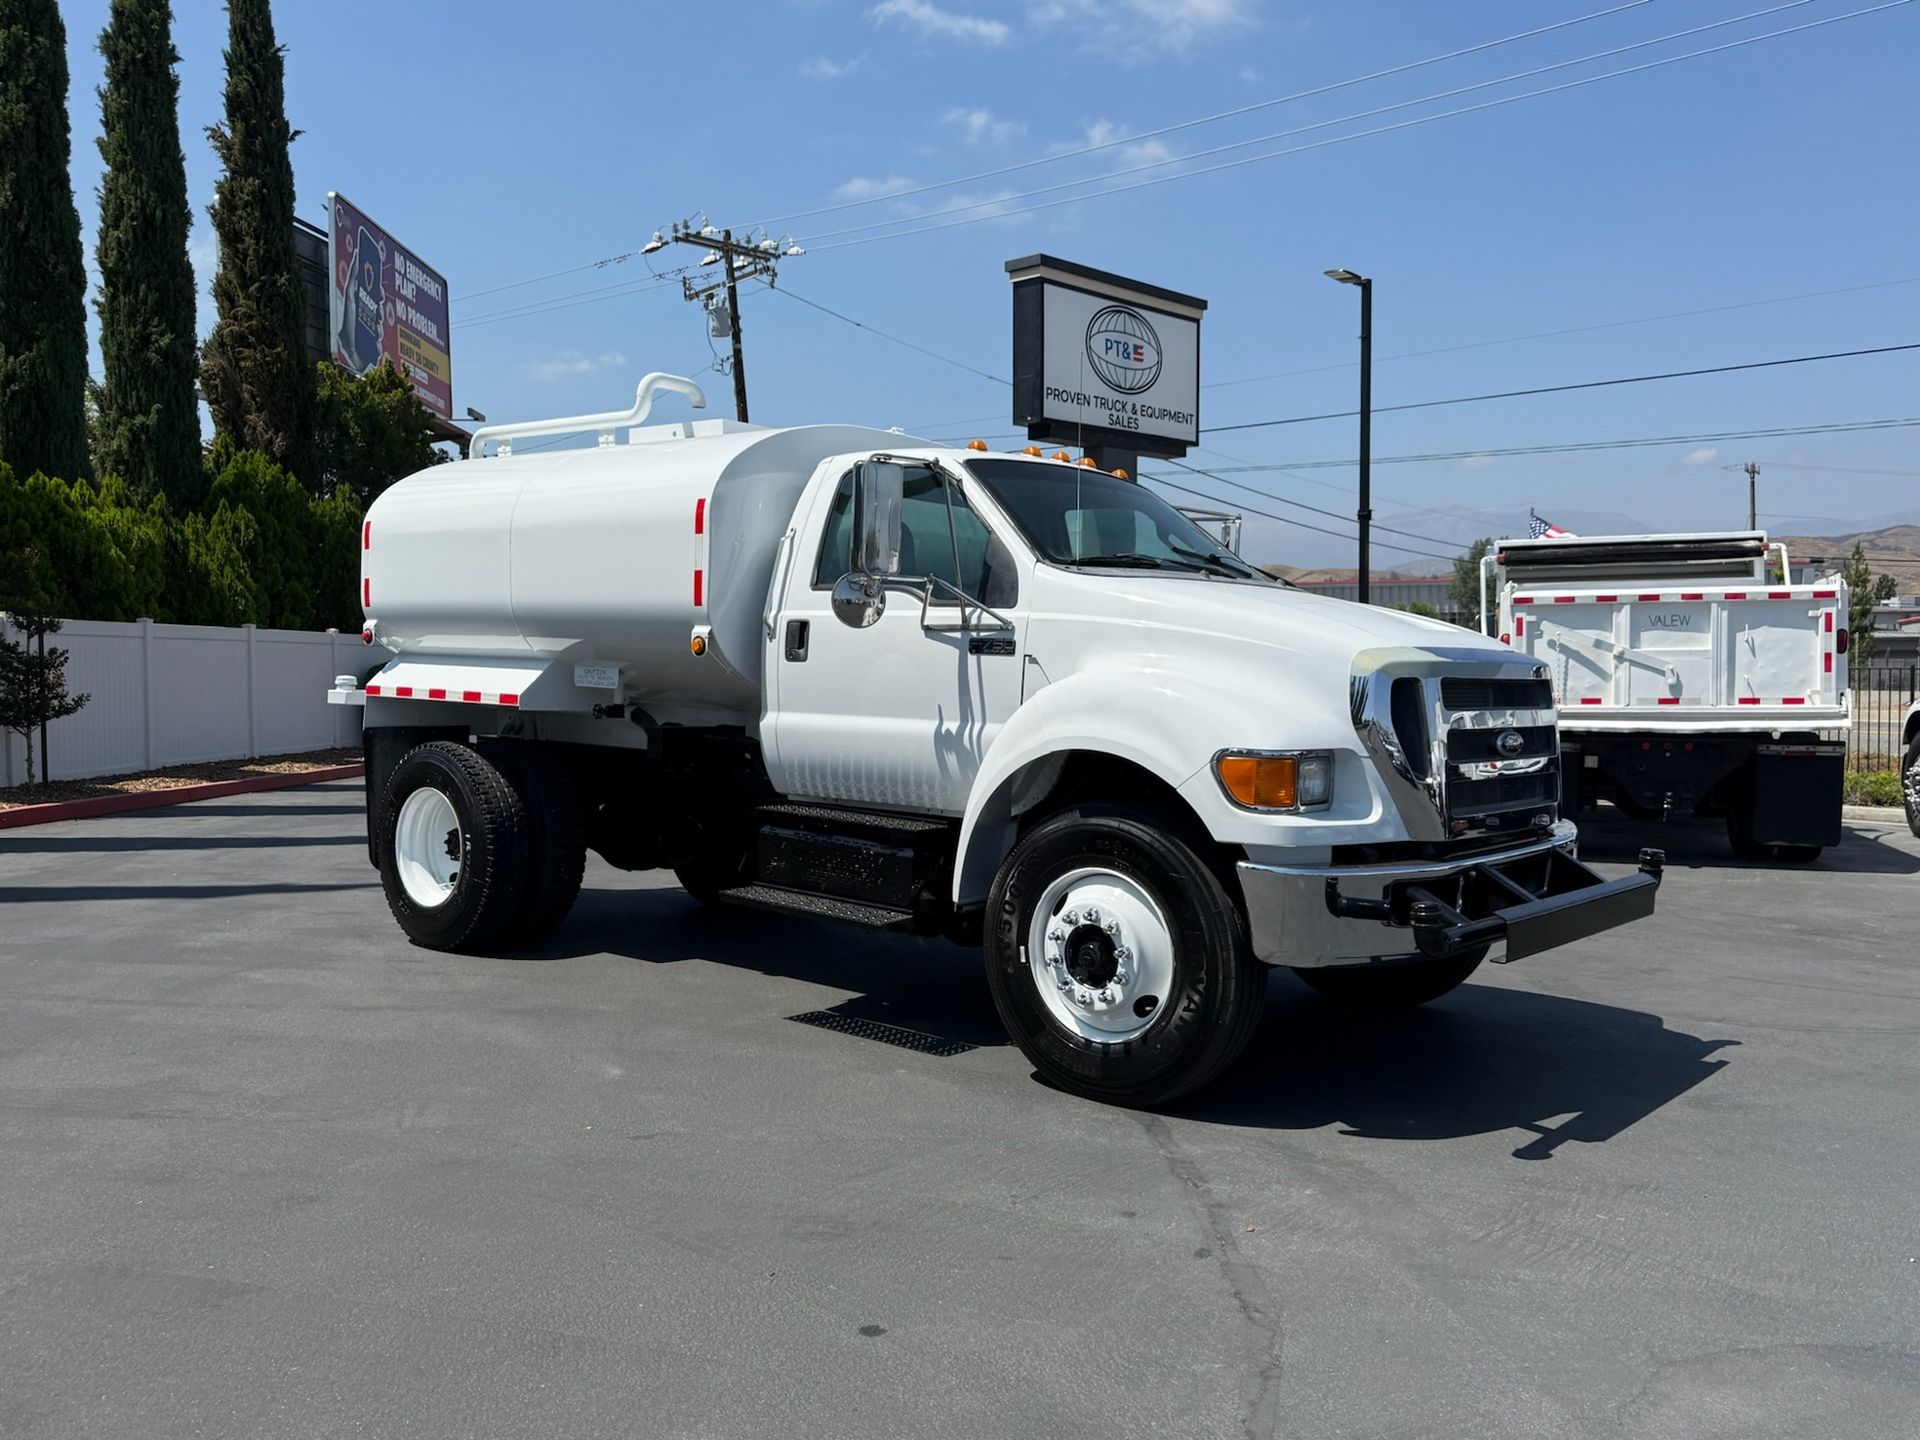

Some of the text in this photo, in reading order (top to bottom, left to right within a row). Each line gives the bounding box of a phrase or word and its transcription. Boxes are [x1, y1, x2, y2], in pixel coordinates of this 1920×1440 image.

[395, 250, 442, 303] NO EMERGENCY
[395, 271, 416, 303] PLAN?
[396, 298, 407, 321] NO
[1046, 387, 1195, 426] PROVEN TRUCK & EQUIPMENT
[1108, 413, 1139, 431] SALES
[1648, 614, 1692, 627] VALEW
